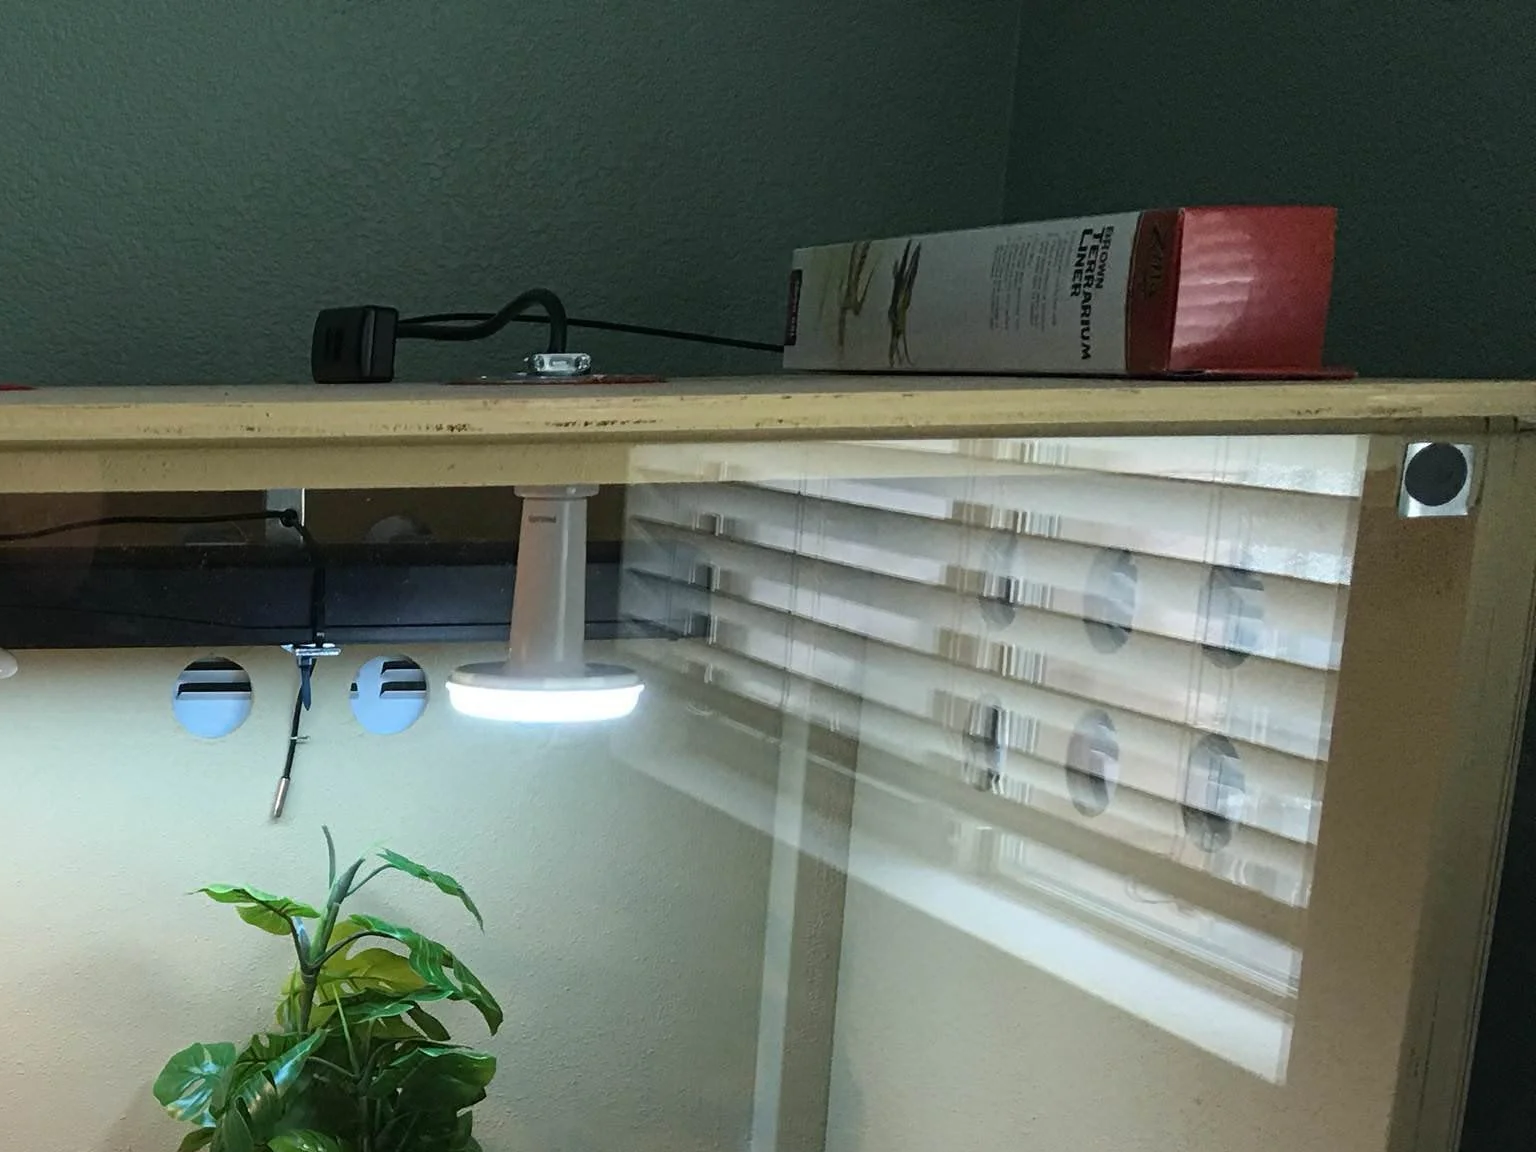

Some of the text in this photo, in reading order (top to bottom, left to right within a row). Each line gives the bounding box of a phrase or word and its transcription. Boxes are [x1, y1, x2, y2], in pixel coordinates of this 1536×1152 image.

[1070, 228, 1094, 297] LINER
[1095, 226, 1115, 289] BROWN
[1080, 227, 1107, 360] TERRARIUM
